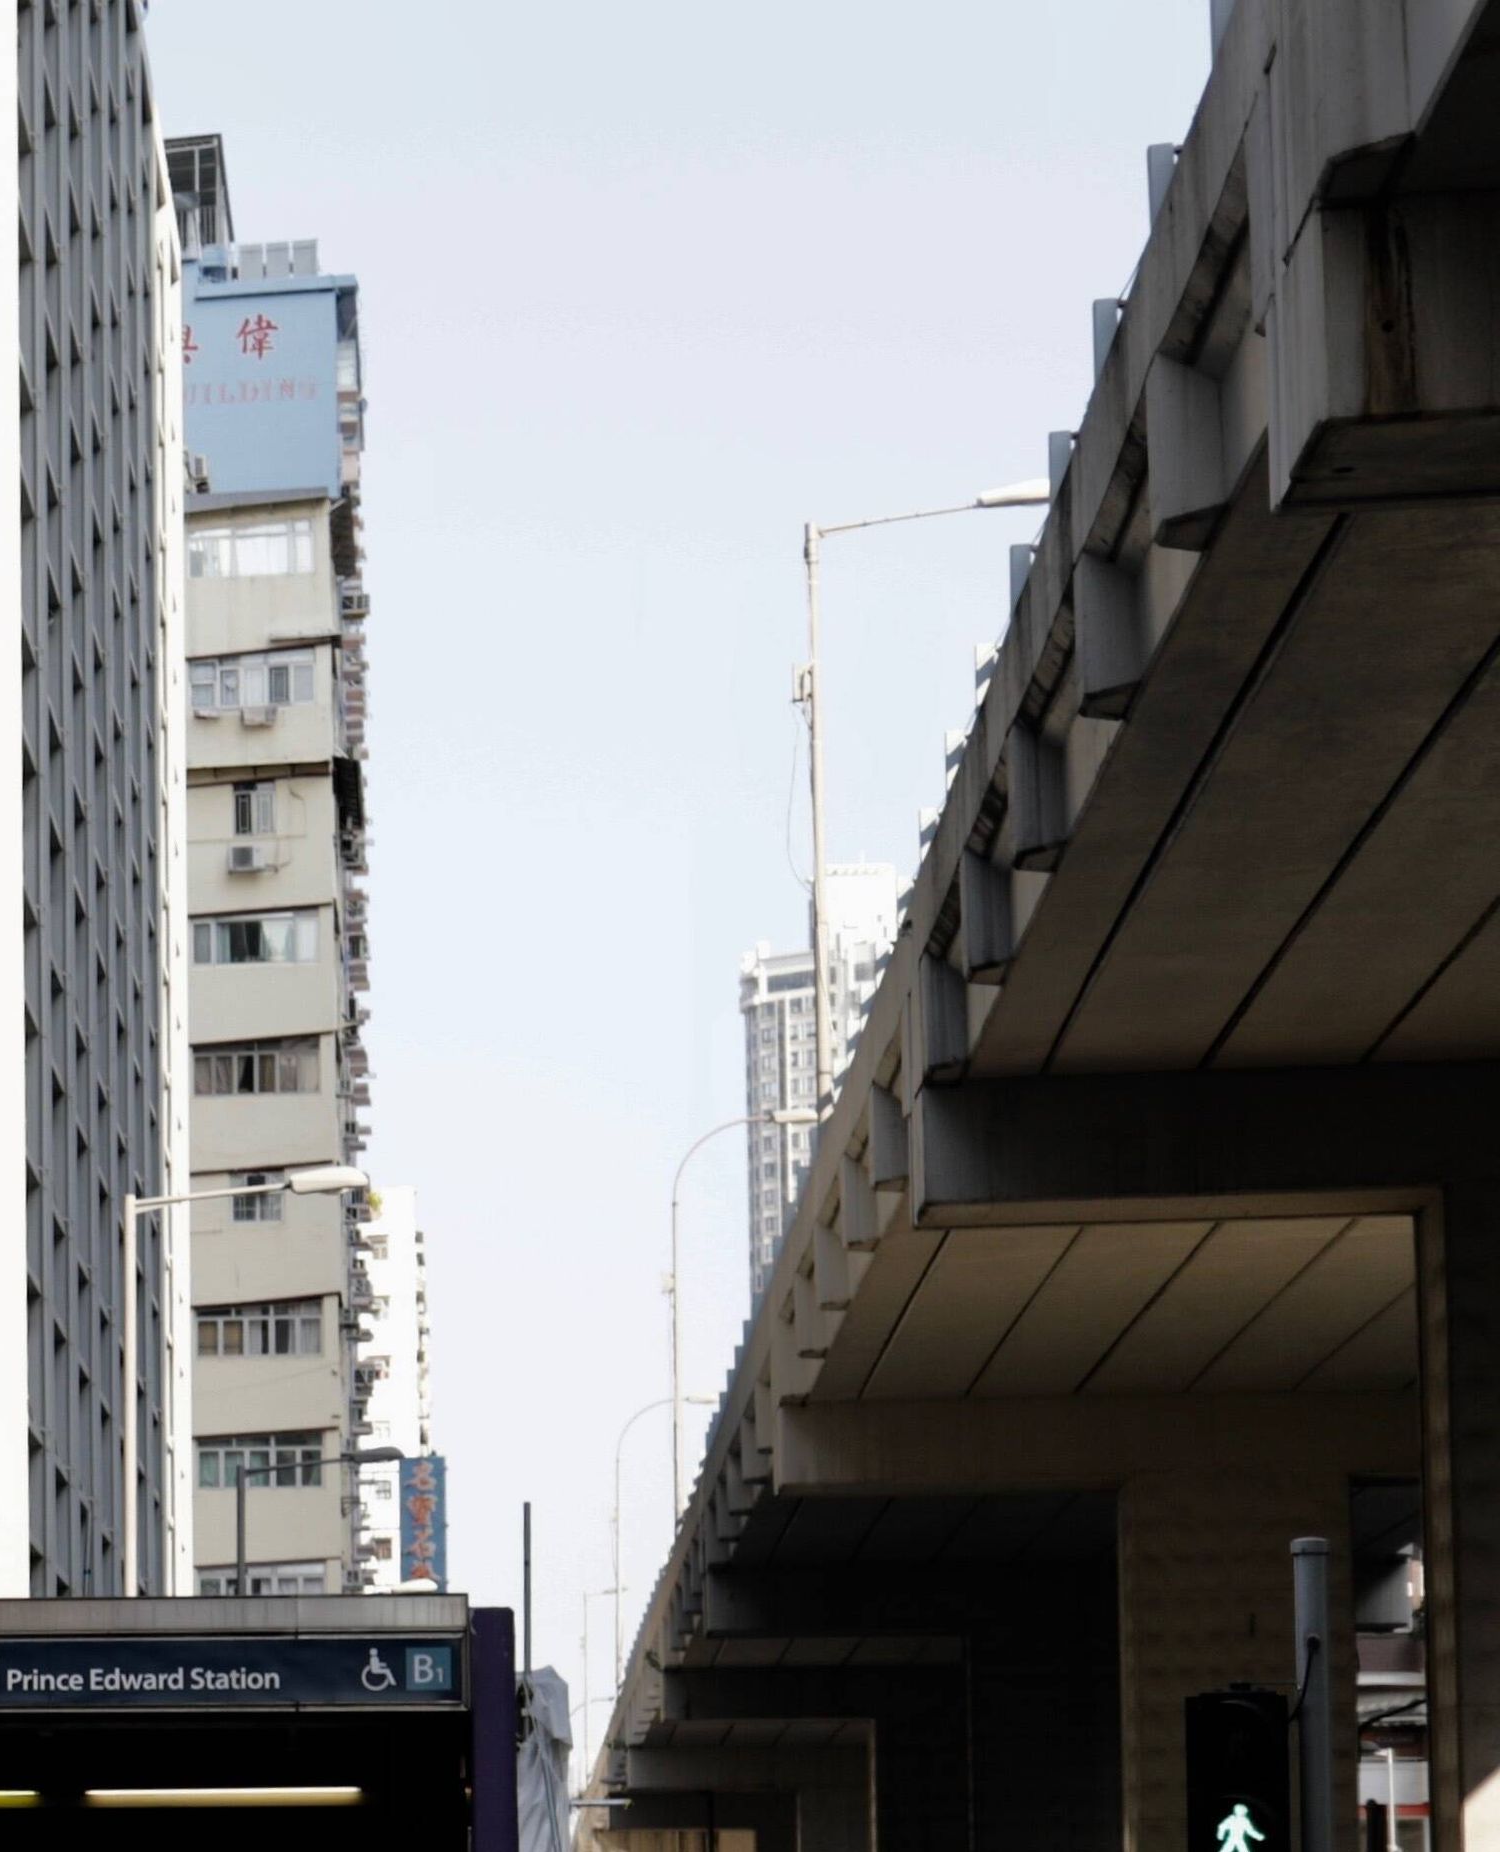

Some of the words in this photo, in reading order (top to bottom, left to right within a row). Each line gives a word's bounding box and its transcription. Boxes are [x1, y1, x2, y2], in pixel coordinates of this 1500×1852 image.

[7, 1667, 85, 1692] Prince
[90, 1667, 186, 1692] Edward
[190, 1667, 281, 1692] Station
